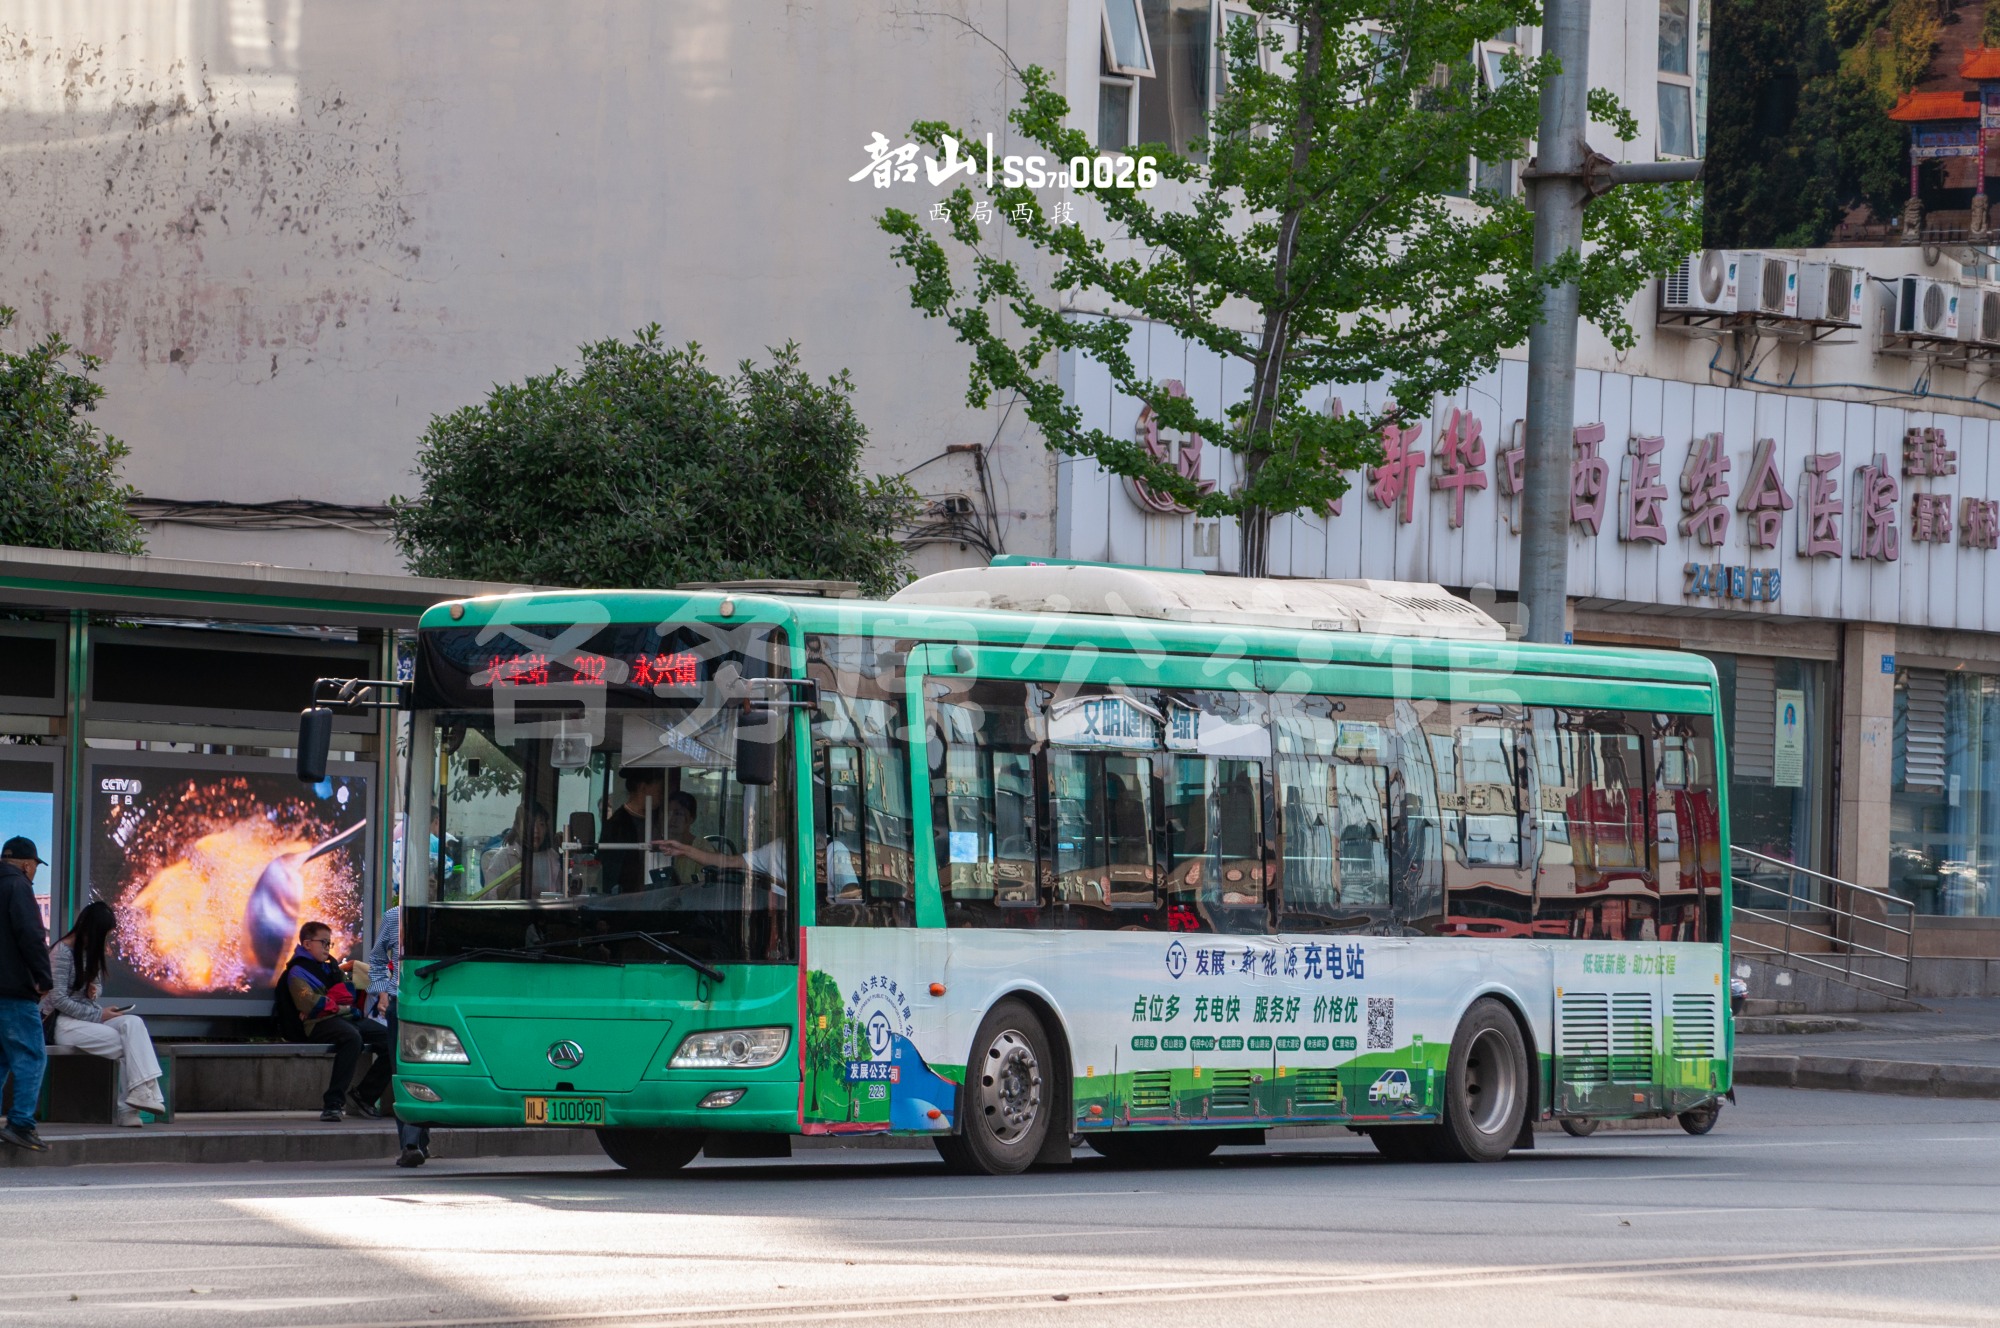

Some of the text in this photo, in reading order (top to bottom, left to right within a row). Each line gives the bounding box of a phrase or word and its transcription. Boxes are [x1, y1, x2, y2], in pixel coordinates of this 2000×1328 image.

[485, 653, 698, 687] 火车站 202 永兴镇
[1132, 994, 1358, 1023] 点位多 充电快 服务好 价格优
[869, 1084, 885, 1099] 223
